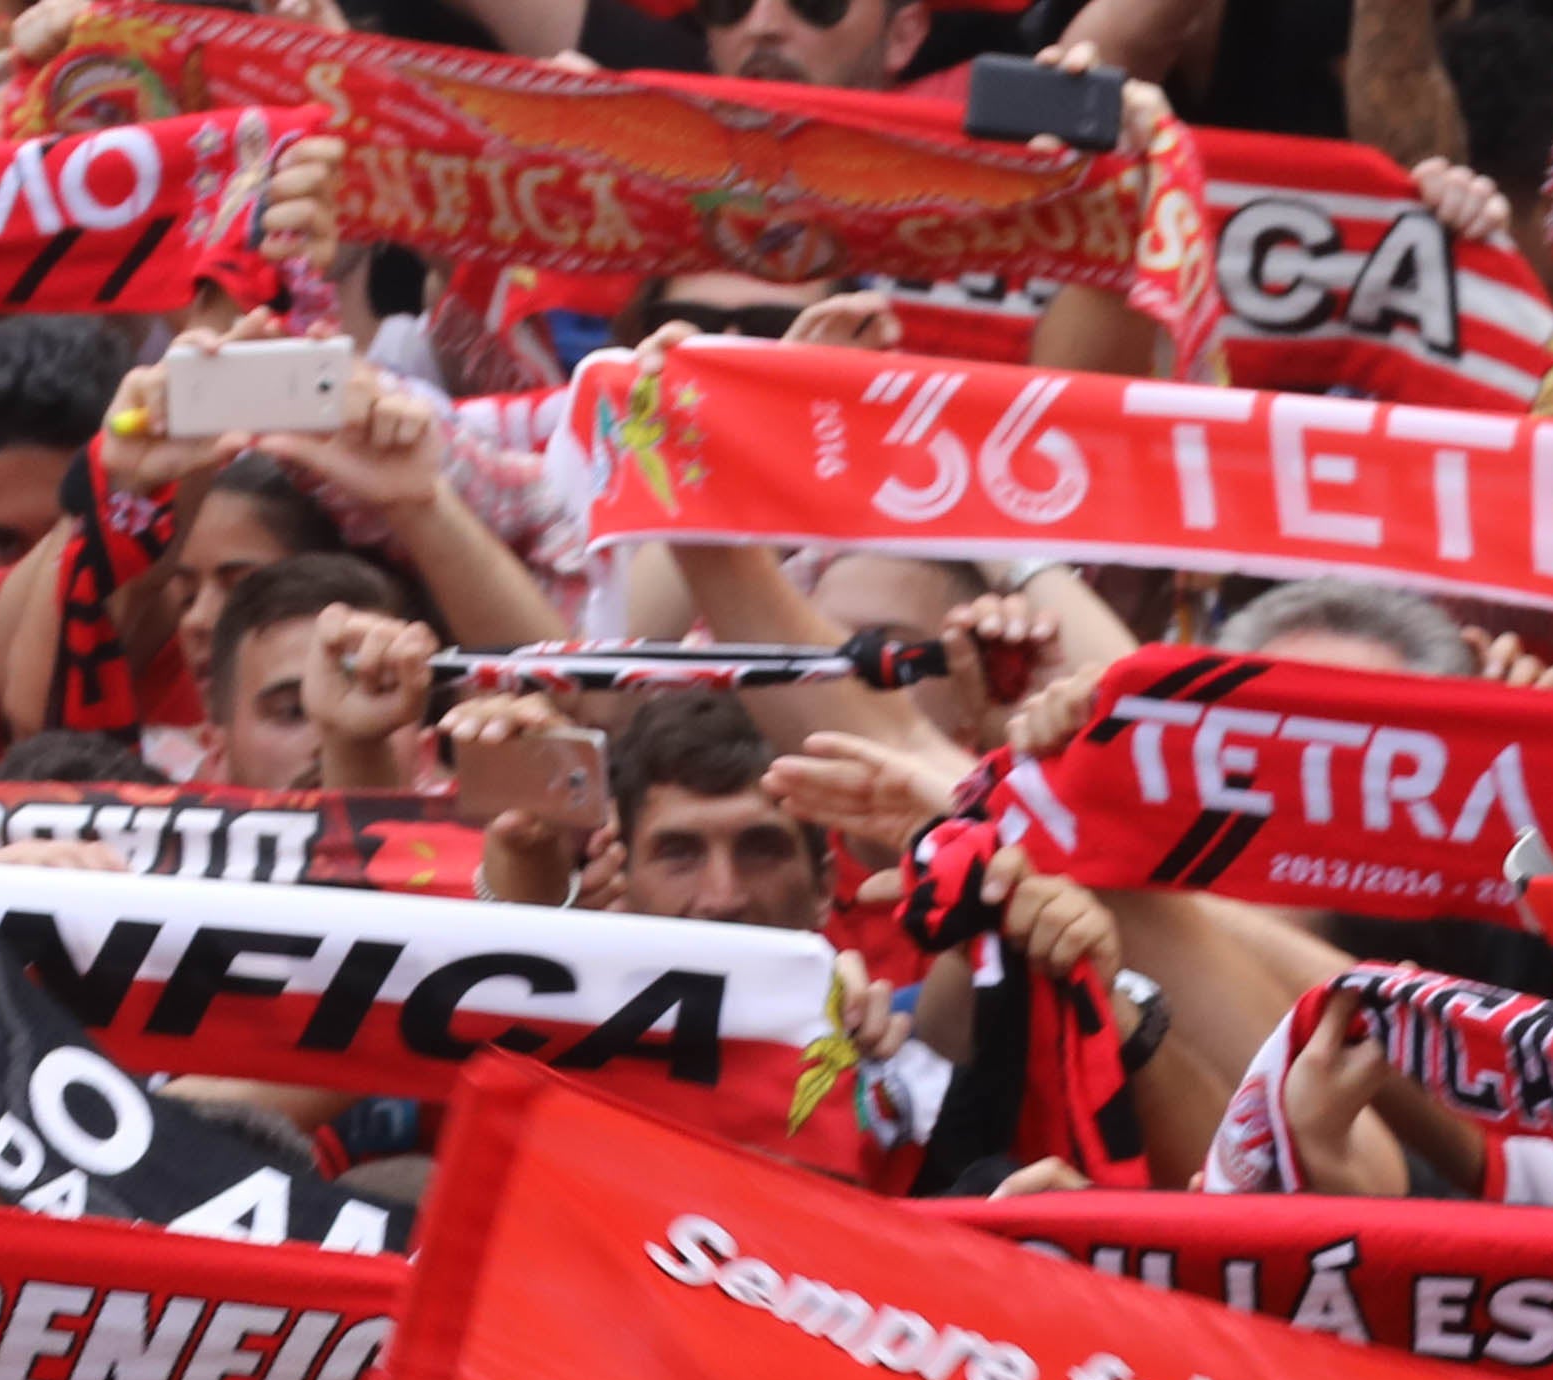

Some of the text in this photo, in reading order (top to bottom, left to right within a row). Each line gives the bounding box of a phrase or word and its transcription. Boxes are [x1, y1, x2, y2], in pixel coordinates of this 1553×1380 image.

[859, 370, 1092, 526] 36
[1107, 695, 1539, 843] TETRA
[1268, 851, 1444, 898] 2013/2014
